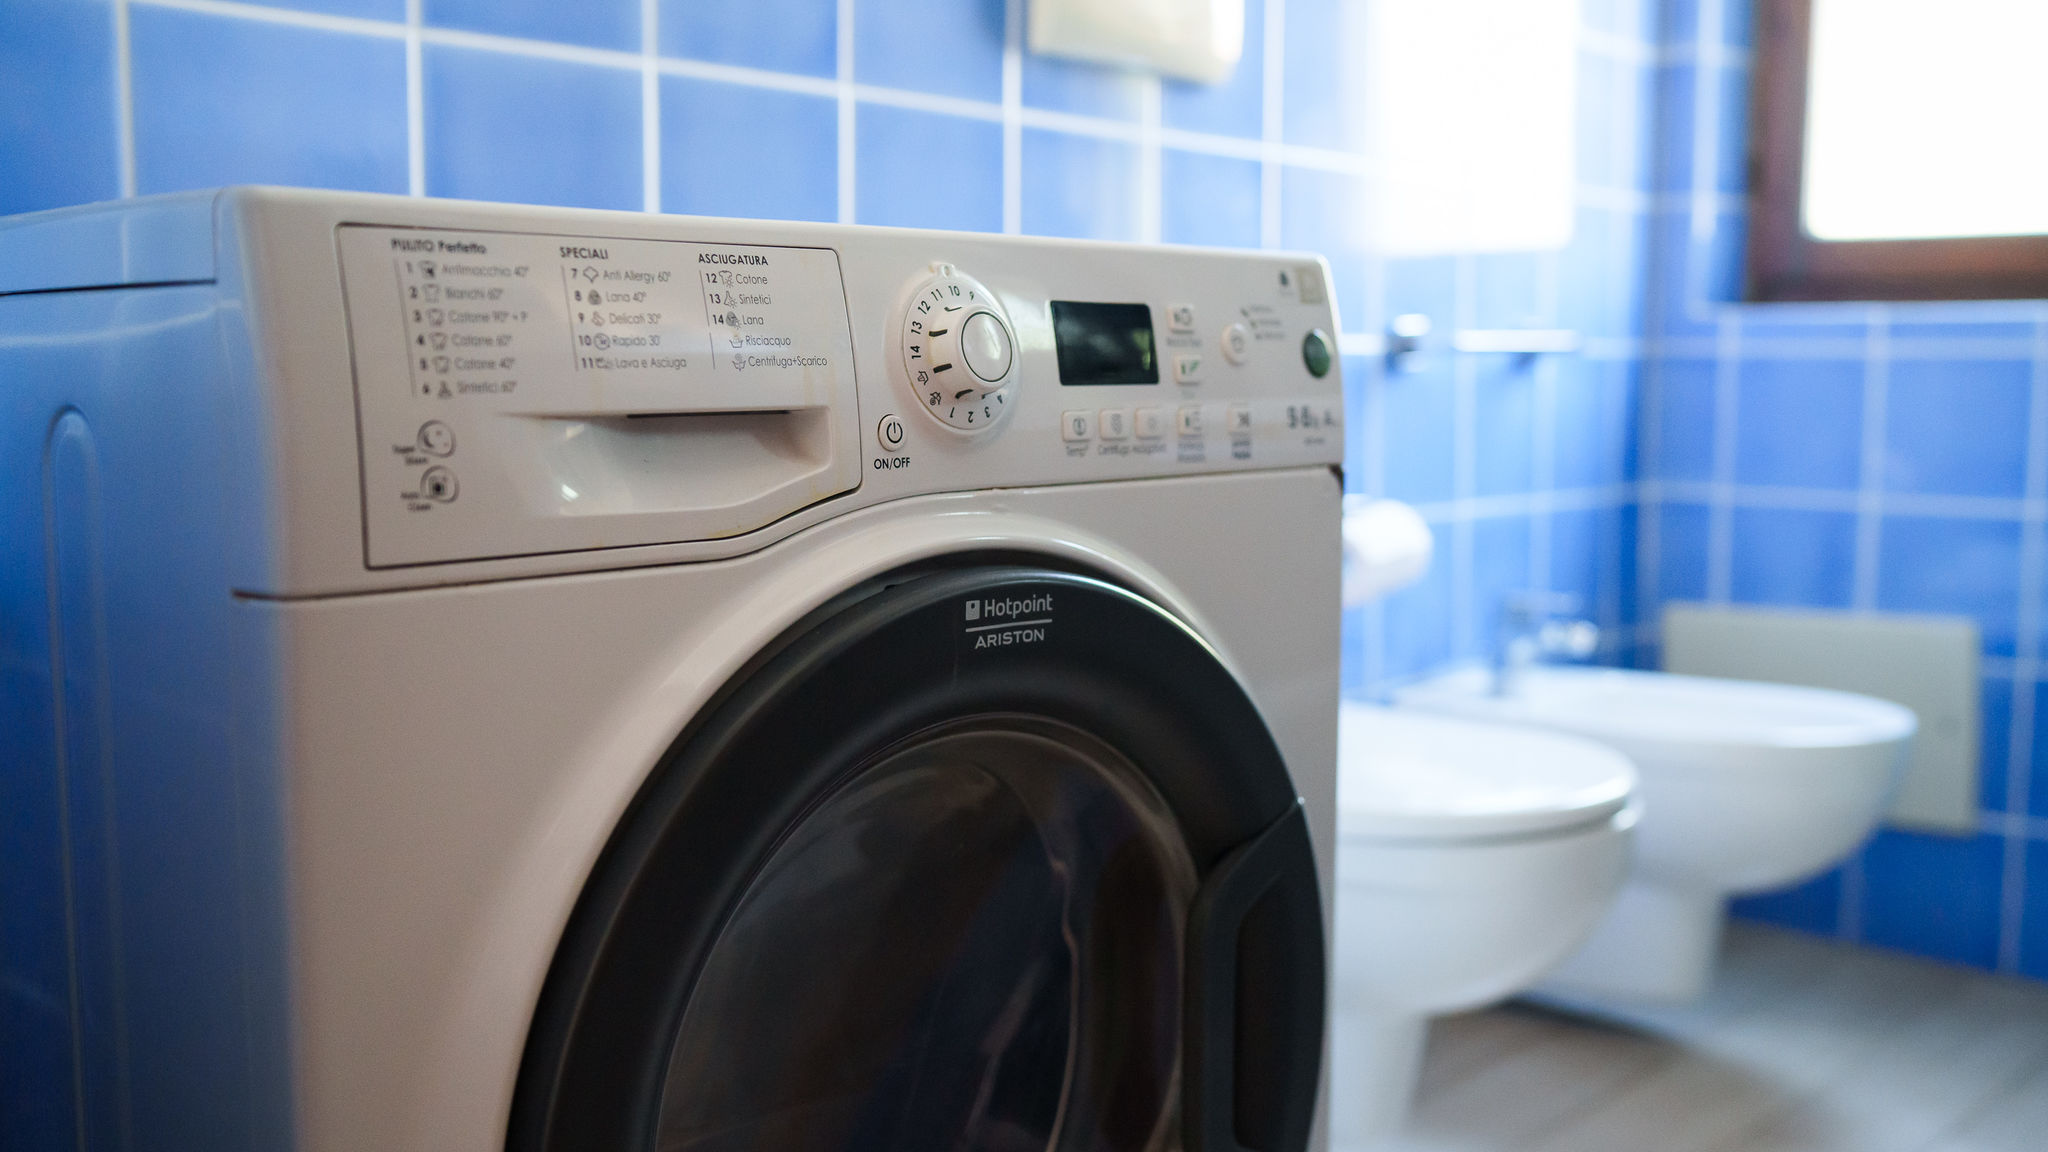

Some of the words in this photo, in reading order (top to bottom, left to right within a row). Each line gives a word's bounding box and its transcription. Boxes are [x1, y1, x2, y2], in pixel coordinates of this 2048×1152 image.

[560, 247, 608, 259] SPECIALI
[698, 253, 768, 265] ASCIUGATURA
[571, 268, 577, 278] 7
[603, 270, 622, 280] Anti
[624, 270, 655, 284] Allergy
[706, 273, 717, 283] 12
[736, 273, 768, 285] Cotone
[605, 292, 630, 302] Lana
[931, 288, 943, 301] 11
[948, 285, 960, 297] 10
[709, 293, 721, 304] 13
[739, 293, 772, 305] Sintetici
[917, 300, 931, 315] 12
[609, 312, 644, 324] Delicati
[712, 314, 724, 324] 14
[742, 314, 764, 325] Lana
[911, 321, 923, 335] 13
[579, 335, 592, 346] 10
[612, 335, 646, 348] Rapido
[745, 335, 791, 348] Risciacquo
[911, 345, 922, 360] 14
[582, 358, 593, 368] 11
[615, 359, 639, 368] Lava
[641, 360, 647, 368] e
[651, 358, 687, 370] Asciuga
[748, 355, 828, 368] Centrifuga+Scarico
[968, 411, 974, 423] 2
[873, 457, 911, 470] ON/OFF
[984, 593, 1053, 619] Hotpoint
[974, 628, 1045, 649] ARISTON
